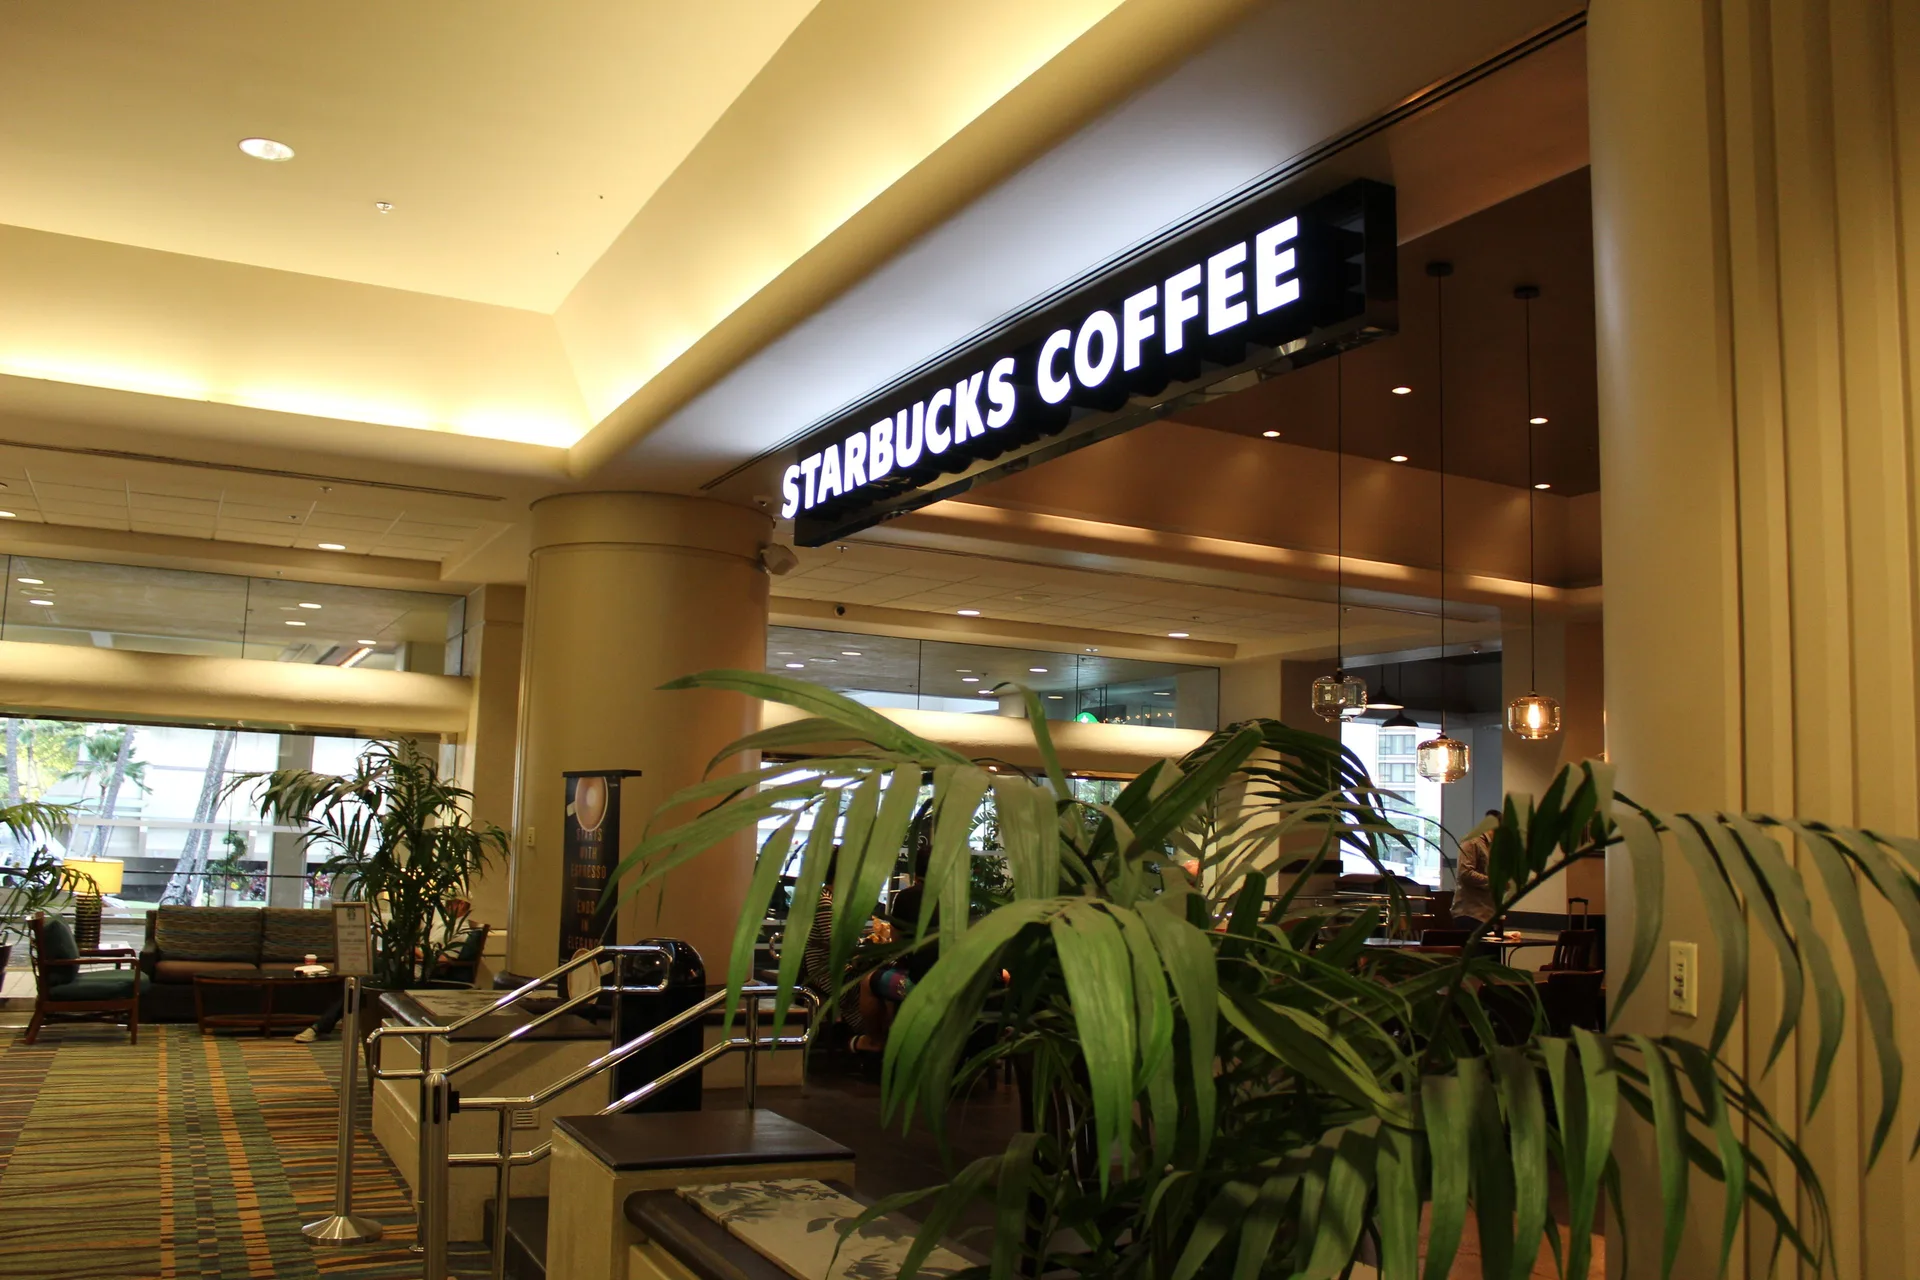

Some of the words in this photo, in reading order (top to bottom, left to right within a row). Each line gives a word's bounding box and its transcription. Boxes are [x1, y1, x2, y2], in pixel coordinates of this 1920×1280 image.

[781, 357, 1016, 519] STARBUCKS
[1036, 215, 1301, 405] COFFEE
[571, 864, 608, 880] ESPRESSO
